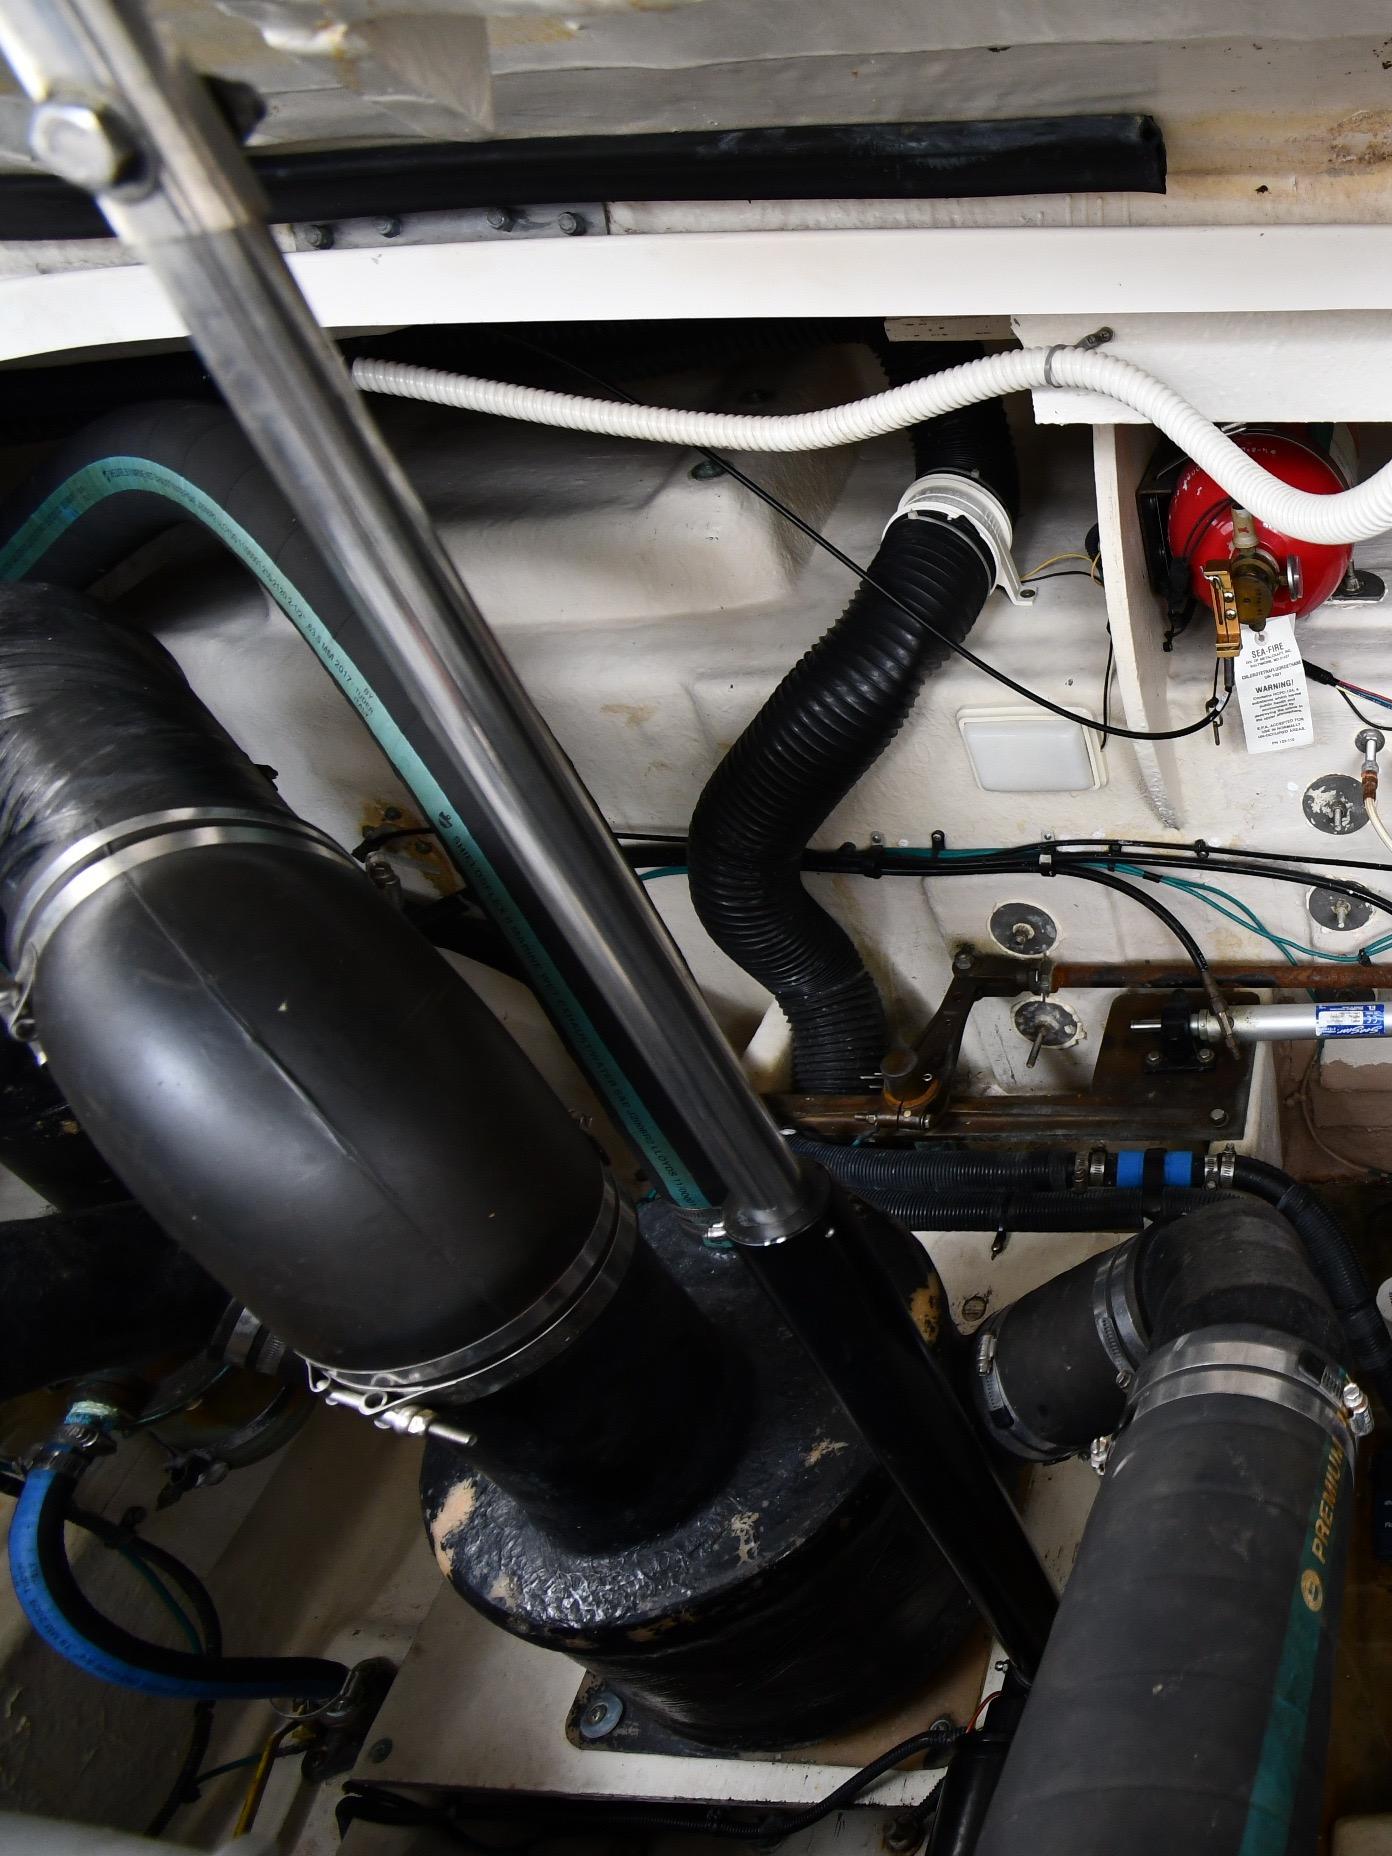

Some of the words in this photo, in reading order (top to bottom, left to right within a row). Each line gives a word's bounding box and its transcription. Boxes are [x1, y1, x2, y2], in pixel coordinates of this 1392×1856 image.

[1251, 642, 1284, 659] SEA-FIRE
[334, 659, 352, 682] 2017
[1255, 679, 1294, 693] WARNING!
